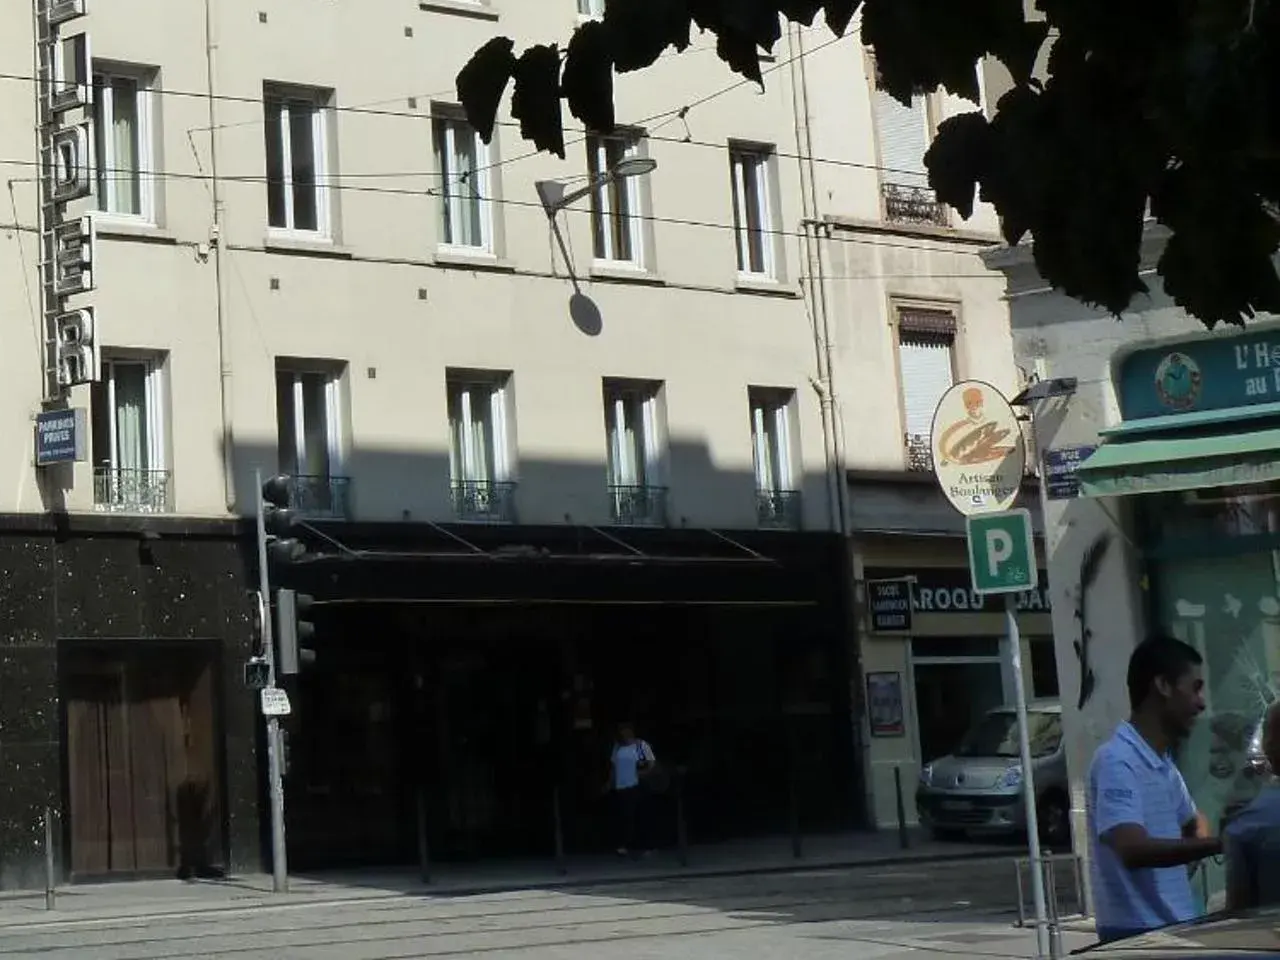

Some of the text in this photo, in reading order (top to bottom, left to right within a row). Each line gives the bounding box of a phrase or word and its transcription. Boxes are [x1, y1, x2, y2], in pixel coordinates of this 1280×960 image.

[1245, 376, 1267, 396] au
[959, 473, 1003, 484] Artisan
[985, 528, 1013, 577] P
